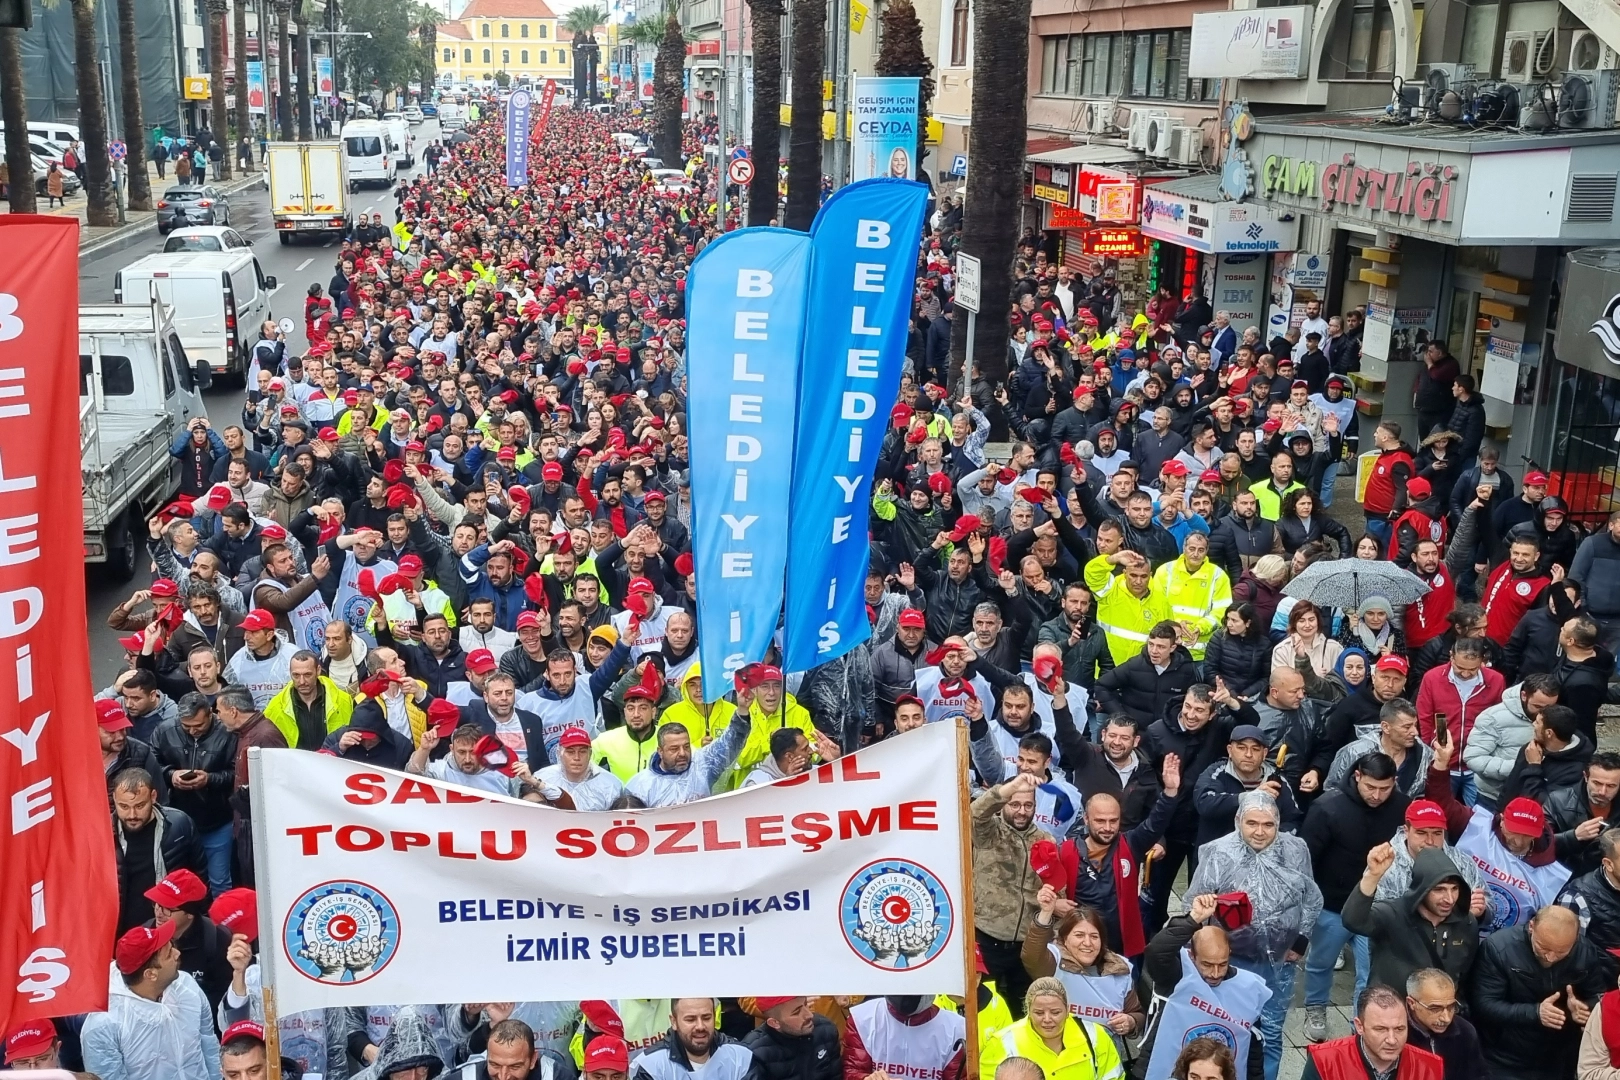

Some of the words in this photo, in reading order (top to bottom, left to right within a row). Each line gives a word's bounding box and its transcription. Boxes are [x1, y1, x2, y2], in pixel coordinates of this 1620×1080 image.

[858, 96, 894, 105] GELİŞİM
[896, 96, 915, 105] İÇİN
[858, 106, 876, 114] TAM
[879, 106, 915, 114] ZAMANI
[513, 109, 525, 163] BELEDİYE
[858, 121, 913, 134] CEYDA
[1263, 154, 1317, 198] ÇAM
[1321, 153, 1457, 221] ÇİFTLİĞİ
[1094, 242, 1135, 252] ECZANESİ
[1101, 234, 1129, 242] BELEN
[1226, 240, 1279, 251] teknolojik
[1222, 289, 1254, 303] IBM
[831, 218, 892, 546] BELEDİYE
[721, 268, 774, 579] BELEDİYE
[816, 577, 841, 654] İŞ
[630, 635, 665, 647] BELEDİYE
[723, 610, 746, 680] İŞ
[540, 719, 585, 736] ELEDİYE-İŞ
[286, 823, 527, 861] TOPLU
[555, 800, 940, 859] SÖZLEŞME
[438, 897, 586, 924] BELEDİYE
[613, 903, 641, 926] İŞ
[651, 888, 810, 924] SENDİKASI
[862, 876, 898, 910] BELEDİYE-İŞ
[306, 896, 344, 931] BELEDİYE-İŞ
[16, 879, 71, 1004] İŞ
[507, 934, 591, 963] İZMİR
[601, 926, 746, 965] ŞUBELERİ
